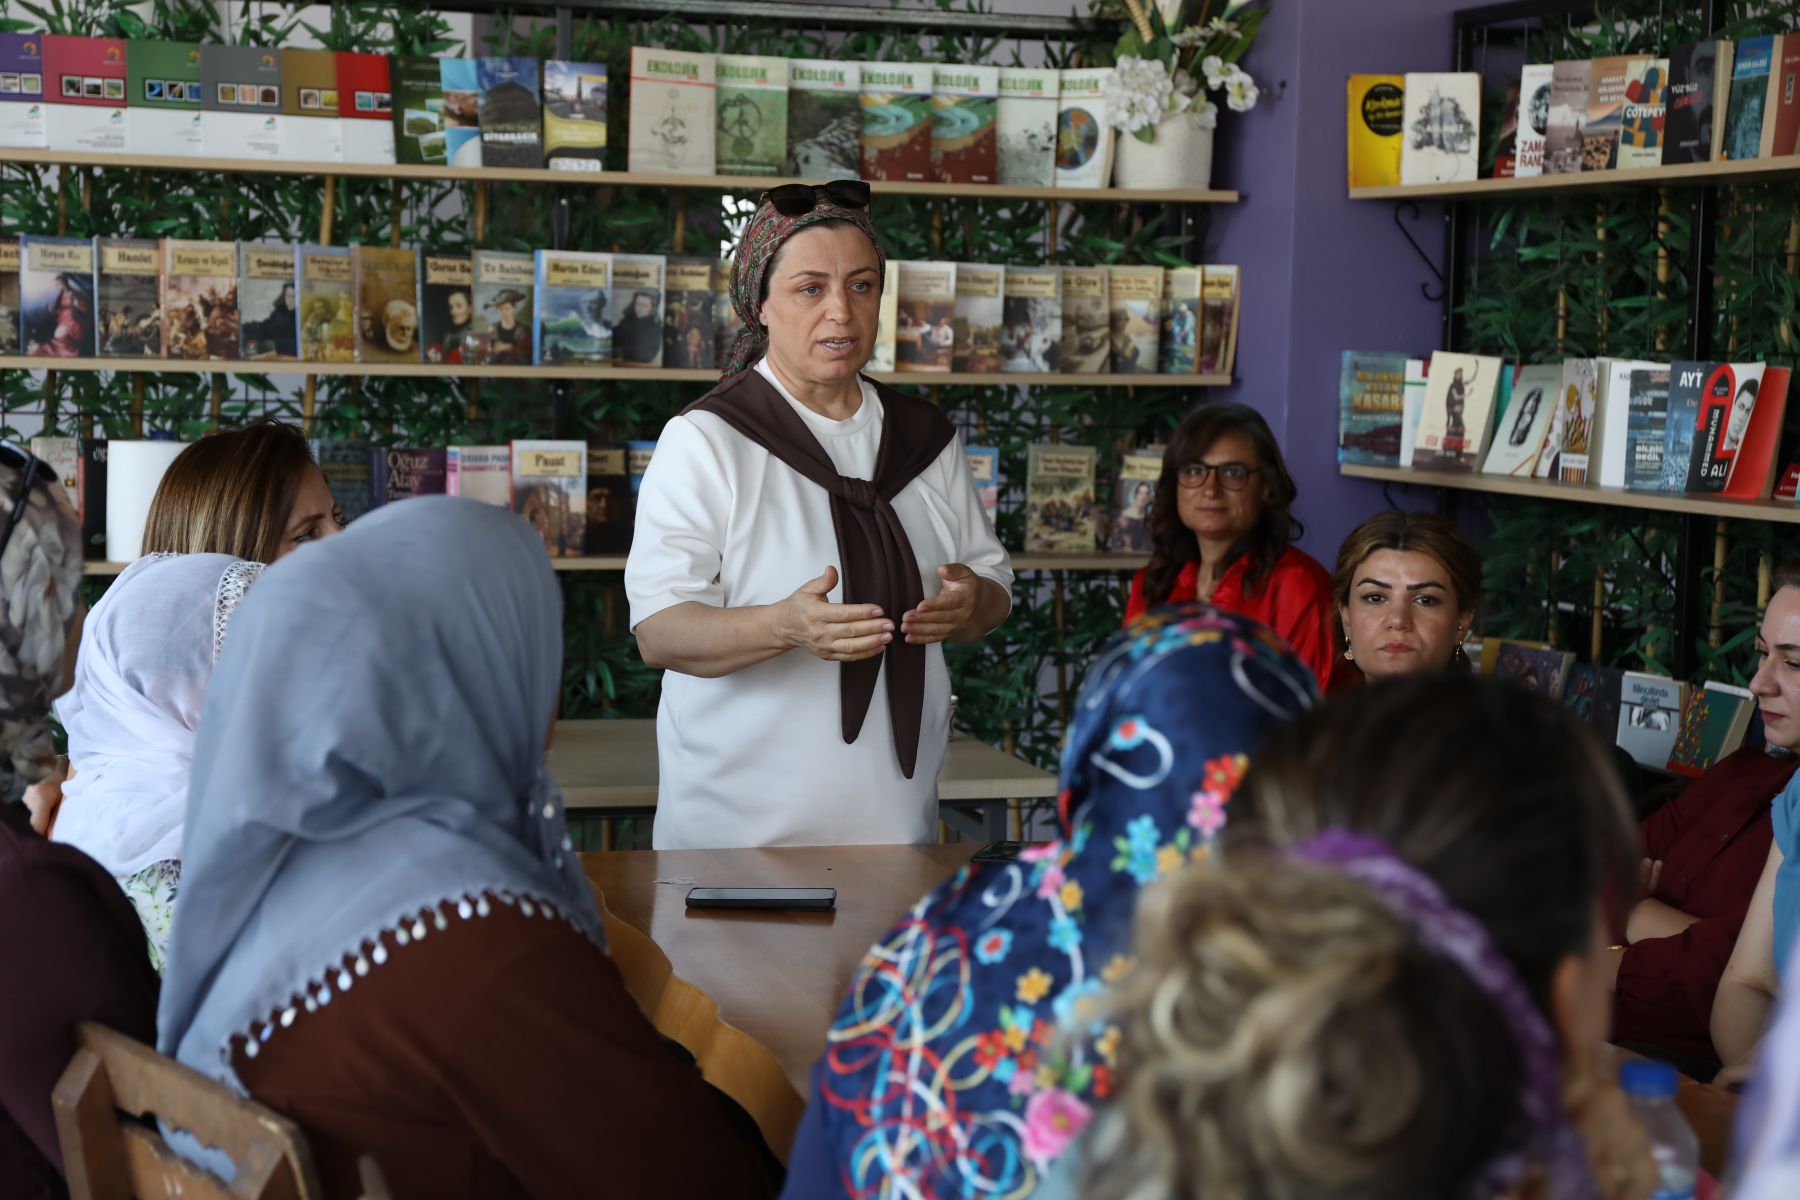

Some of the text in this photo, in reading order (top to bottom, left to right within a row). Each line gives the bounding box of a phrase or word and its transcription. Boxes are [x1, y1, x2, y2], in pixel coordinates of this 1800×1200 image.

[118, 251, 152, 264] Hamlet
[387, 451, 428, 472] Oğuz
[534, 454, 565, 467] Faust
